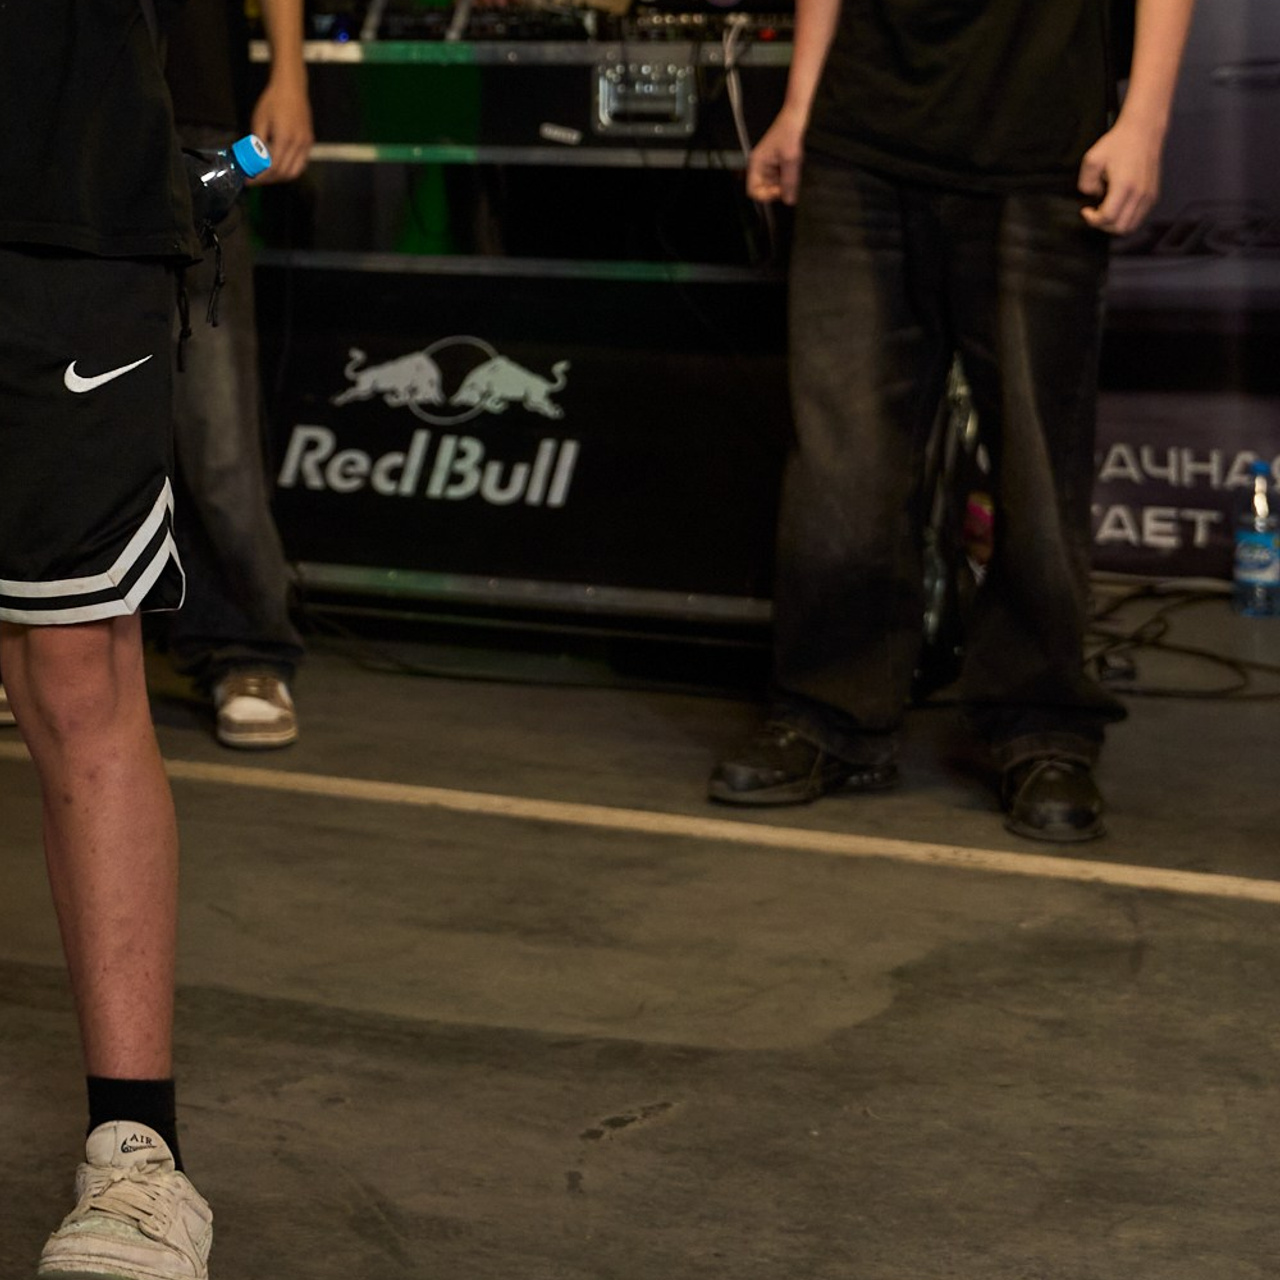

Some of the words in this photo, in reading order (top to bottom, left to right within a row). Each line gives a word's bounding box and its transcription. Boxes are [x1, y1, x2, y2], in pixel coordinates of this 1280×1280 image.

[277, 423, 432, 498] Red
[425, 432, 581, 509] Bull
[1096, 442, 1280, 494] АЧНА
[1090, 503, 1223, 550] АЕТ
[129, 1133, 153, 1146] AIR
